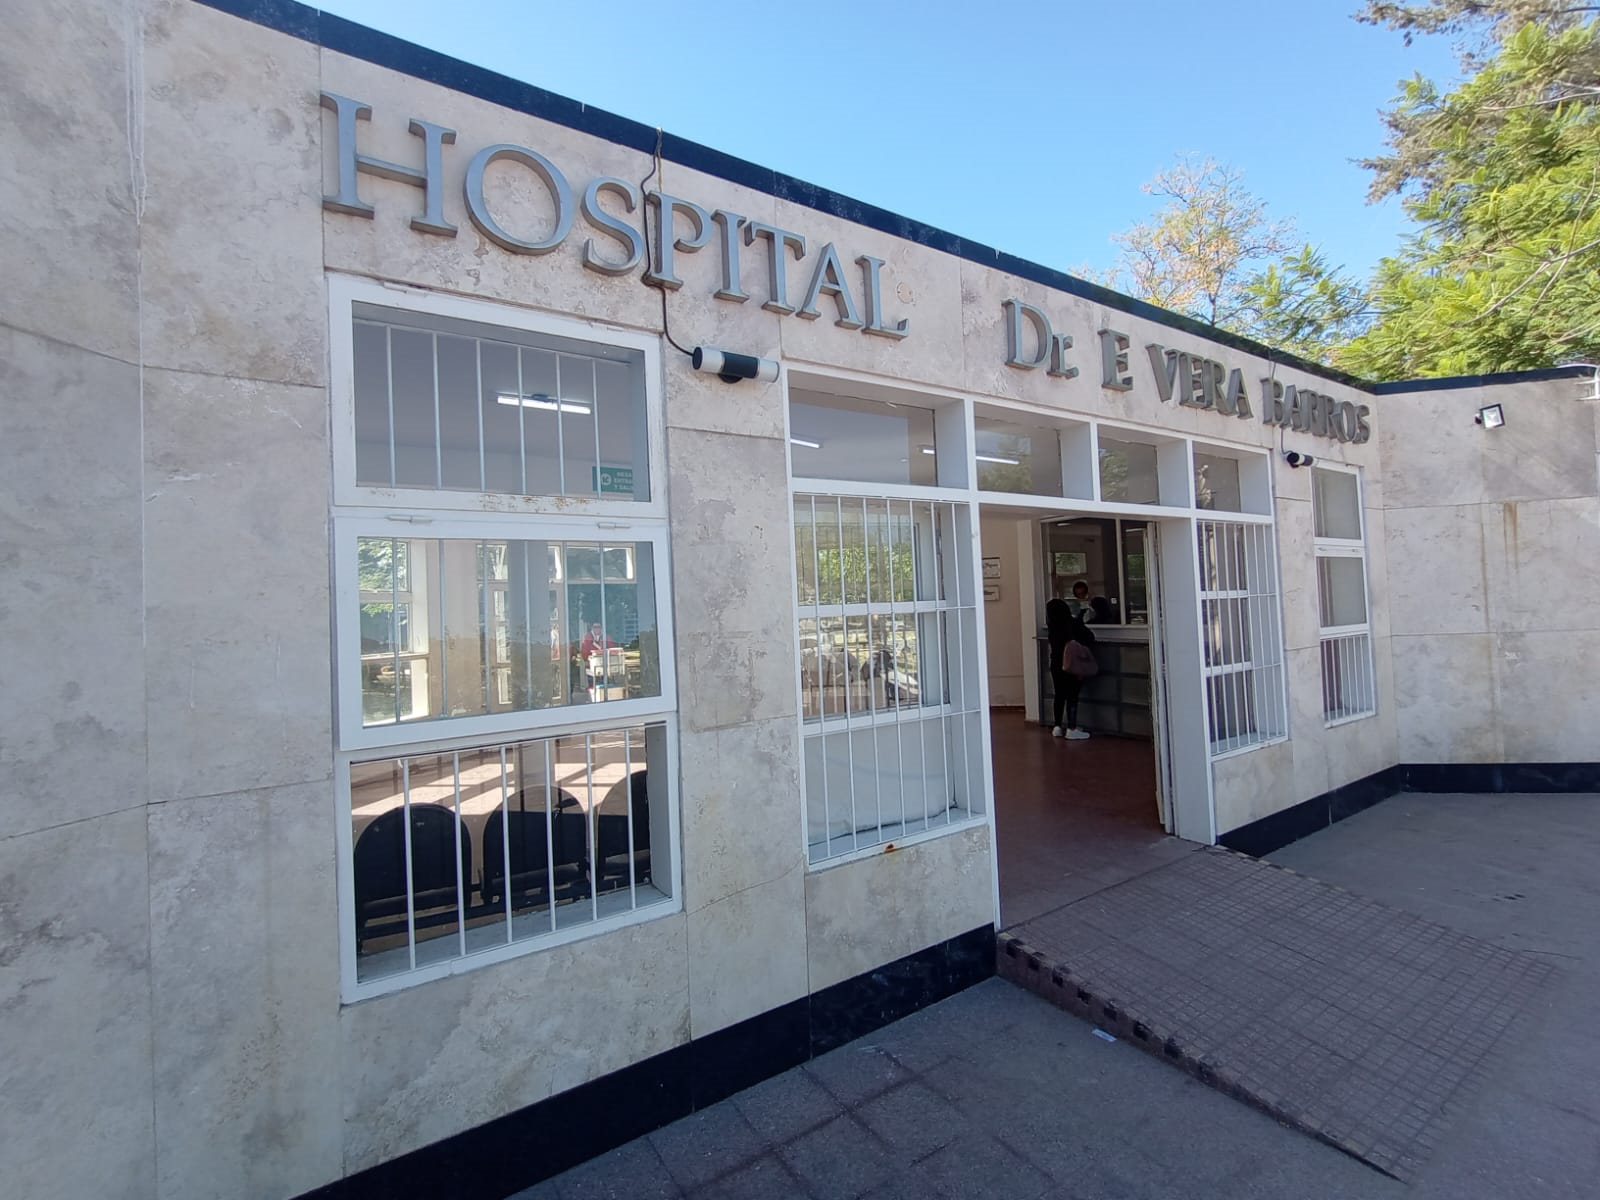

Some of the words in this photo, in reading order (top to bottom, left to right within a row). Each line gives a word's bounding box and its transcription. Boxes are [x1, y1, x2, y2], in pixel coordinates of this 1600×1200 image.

[320, 90, 909, 340] HOSPITAL
[1097, 328, 1134, 392] E
[1145, 343, 1254, 419] VERA
[1260, 376, 1370, 444] BARROS
